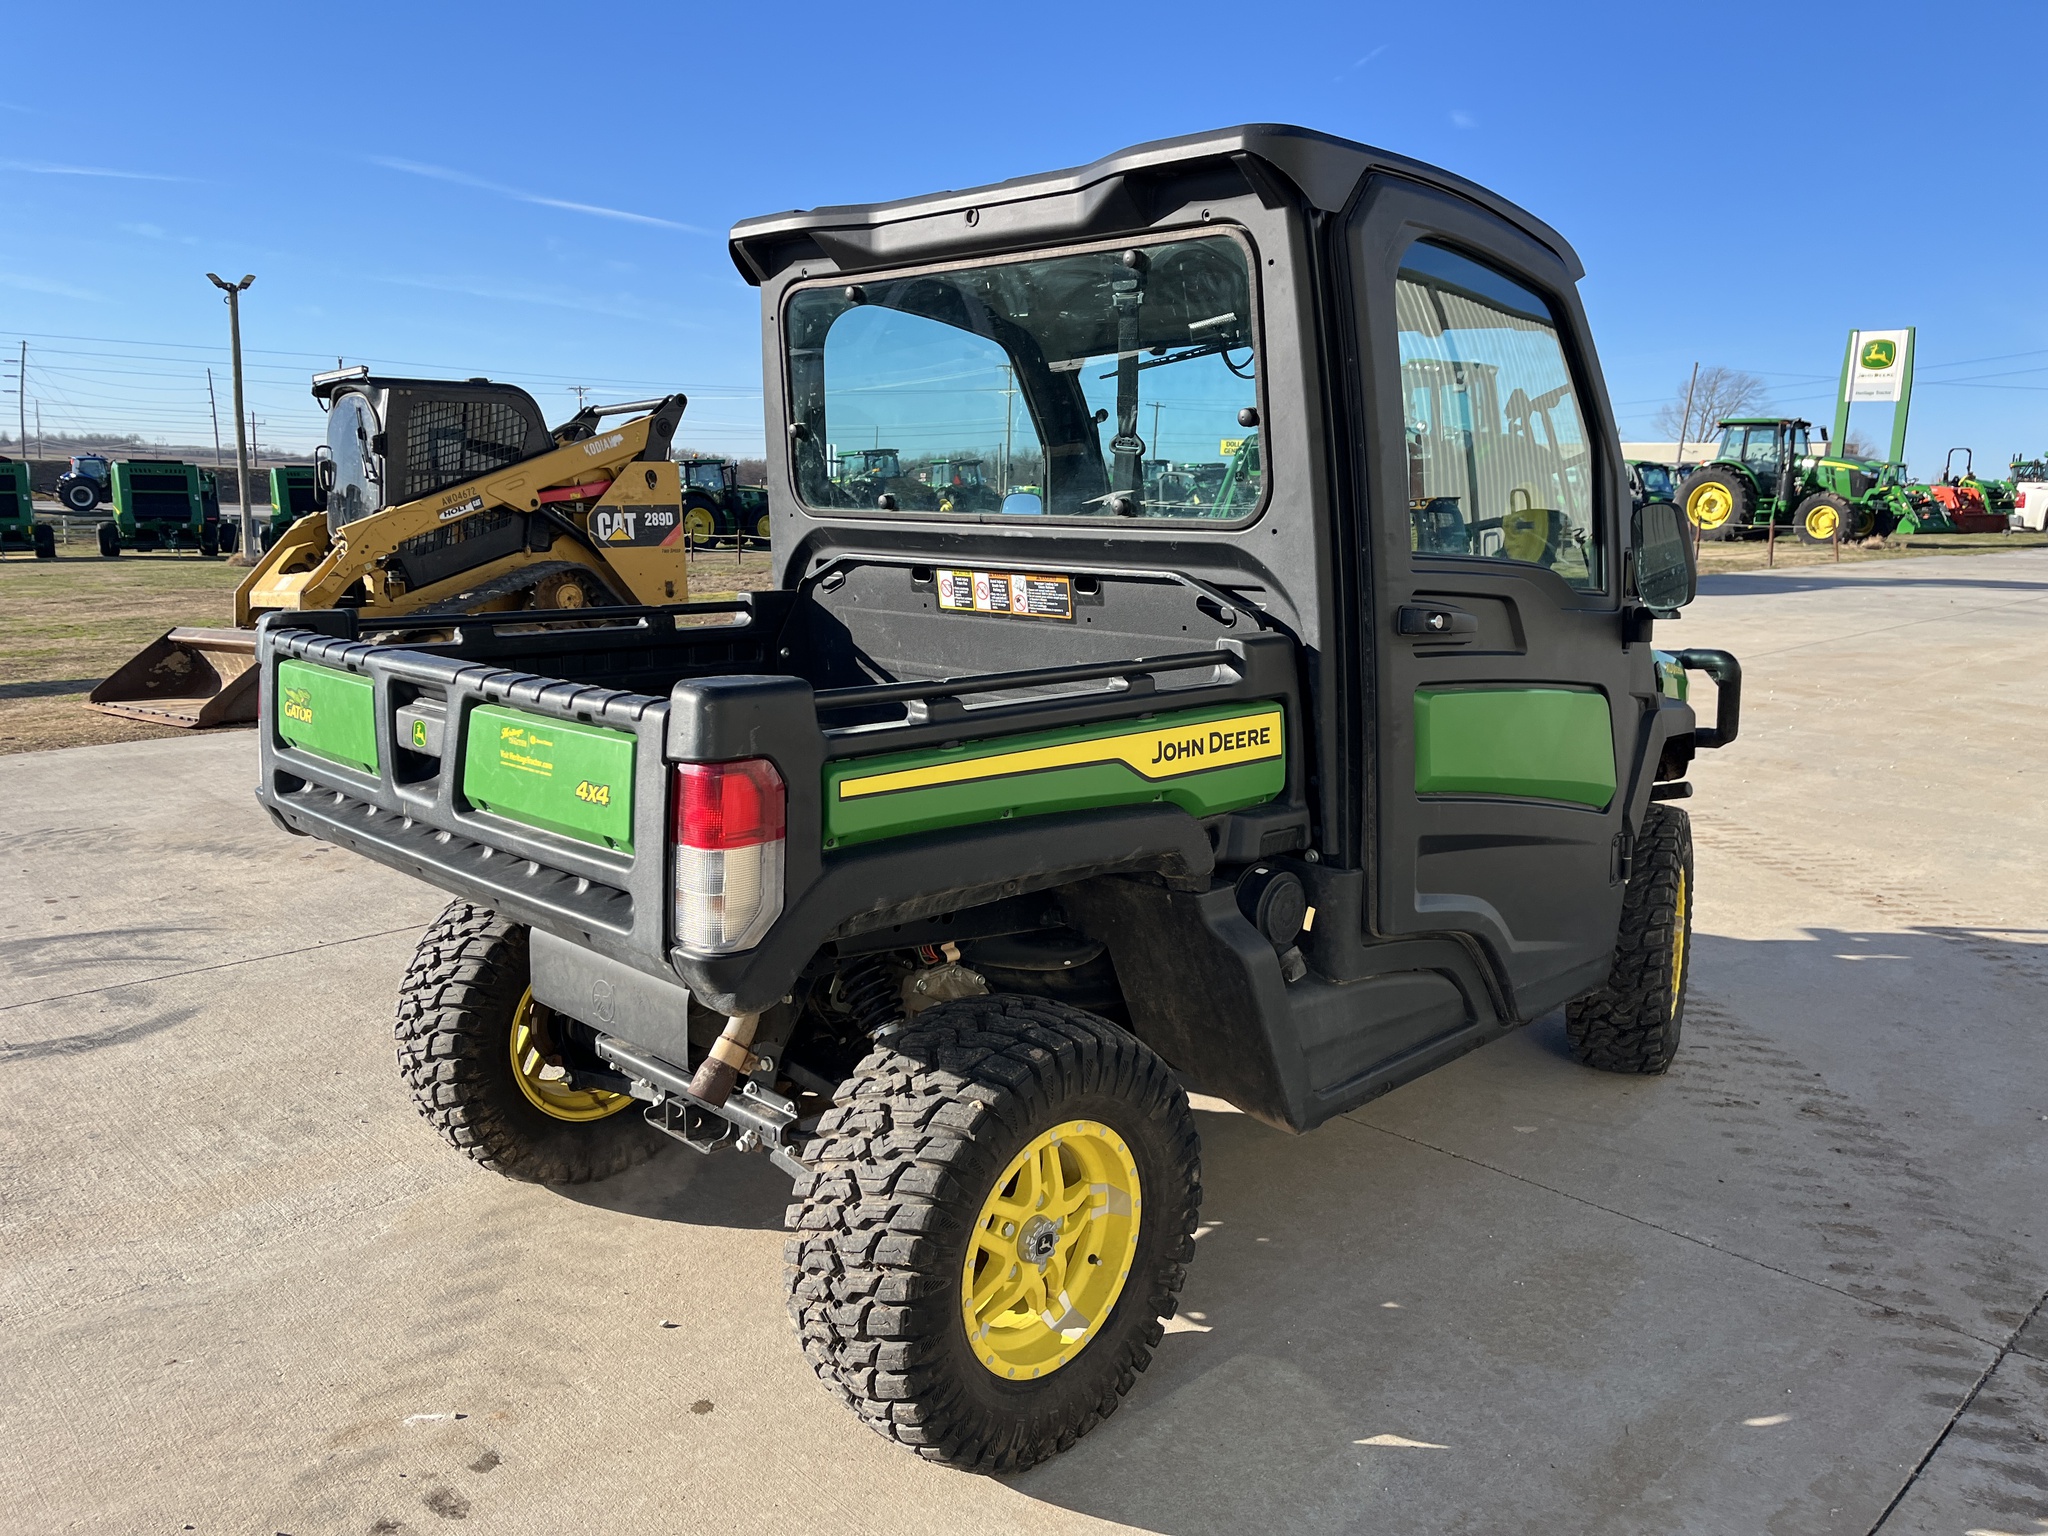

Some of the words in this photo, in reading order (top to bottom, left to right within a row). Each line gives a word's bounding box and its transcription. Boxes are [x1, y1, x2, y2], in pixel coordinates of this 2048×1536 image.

[443, 504, 468, 518] HOLT
[597, 512, 637, 541] CAT
[644, 511, 674, 526] 289D
[284, 700, 313, 724] GATOR
[1152, 738, 1204, 764] JOHN
[1209, 726, 1271, 754] DEERE
